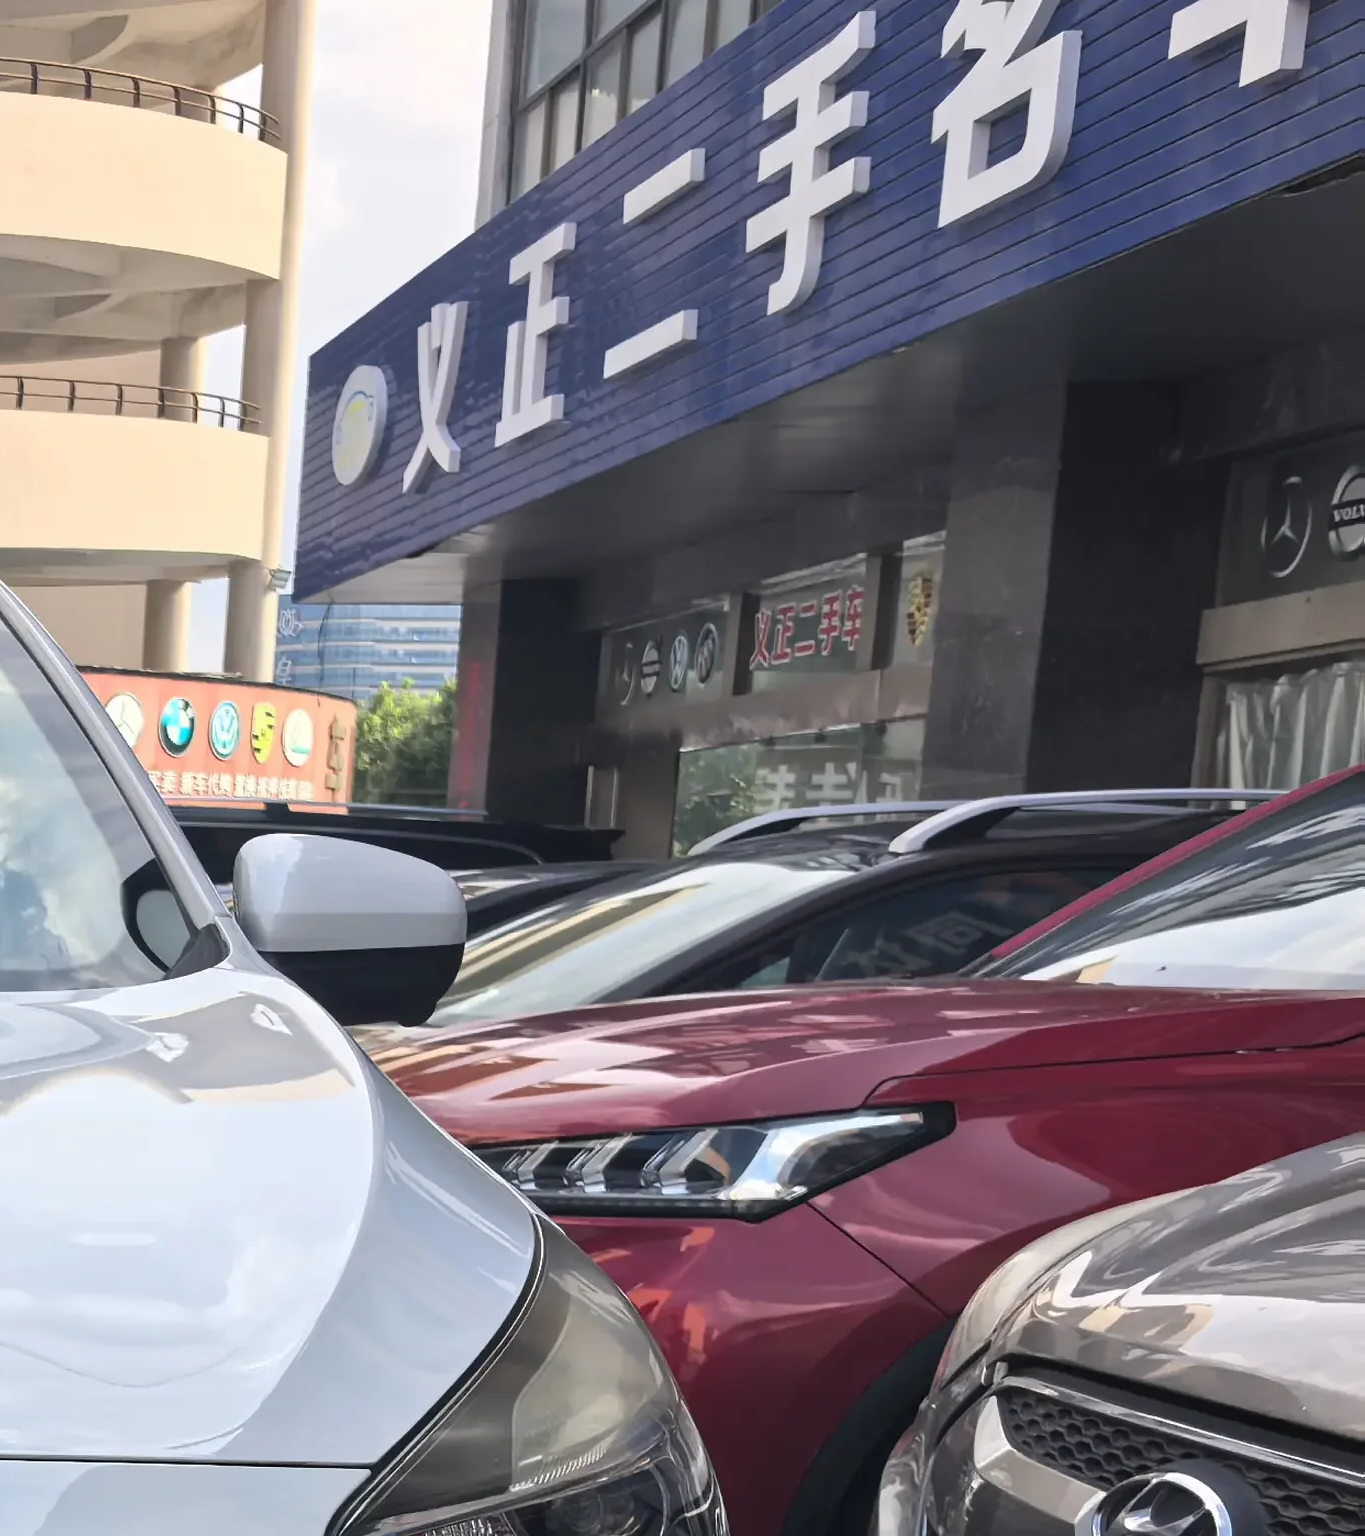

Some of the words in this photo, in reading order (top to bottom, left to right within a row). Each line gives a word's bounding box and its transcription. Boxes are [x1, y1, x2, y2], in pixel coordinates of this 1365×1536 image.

[749, 584, 866, 671] 义正二手车
